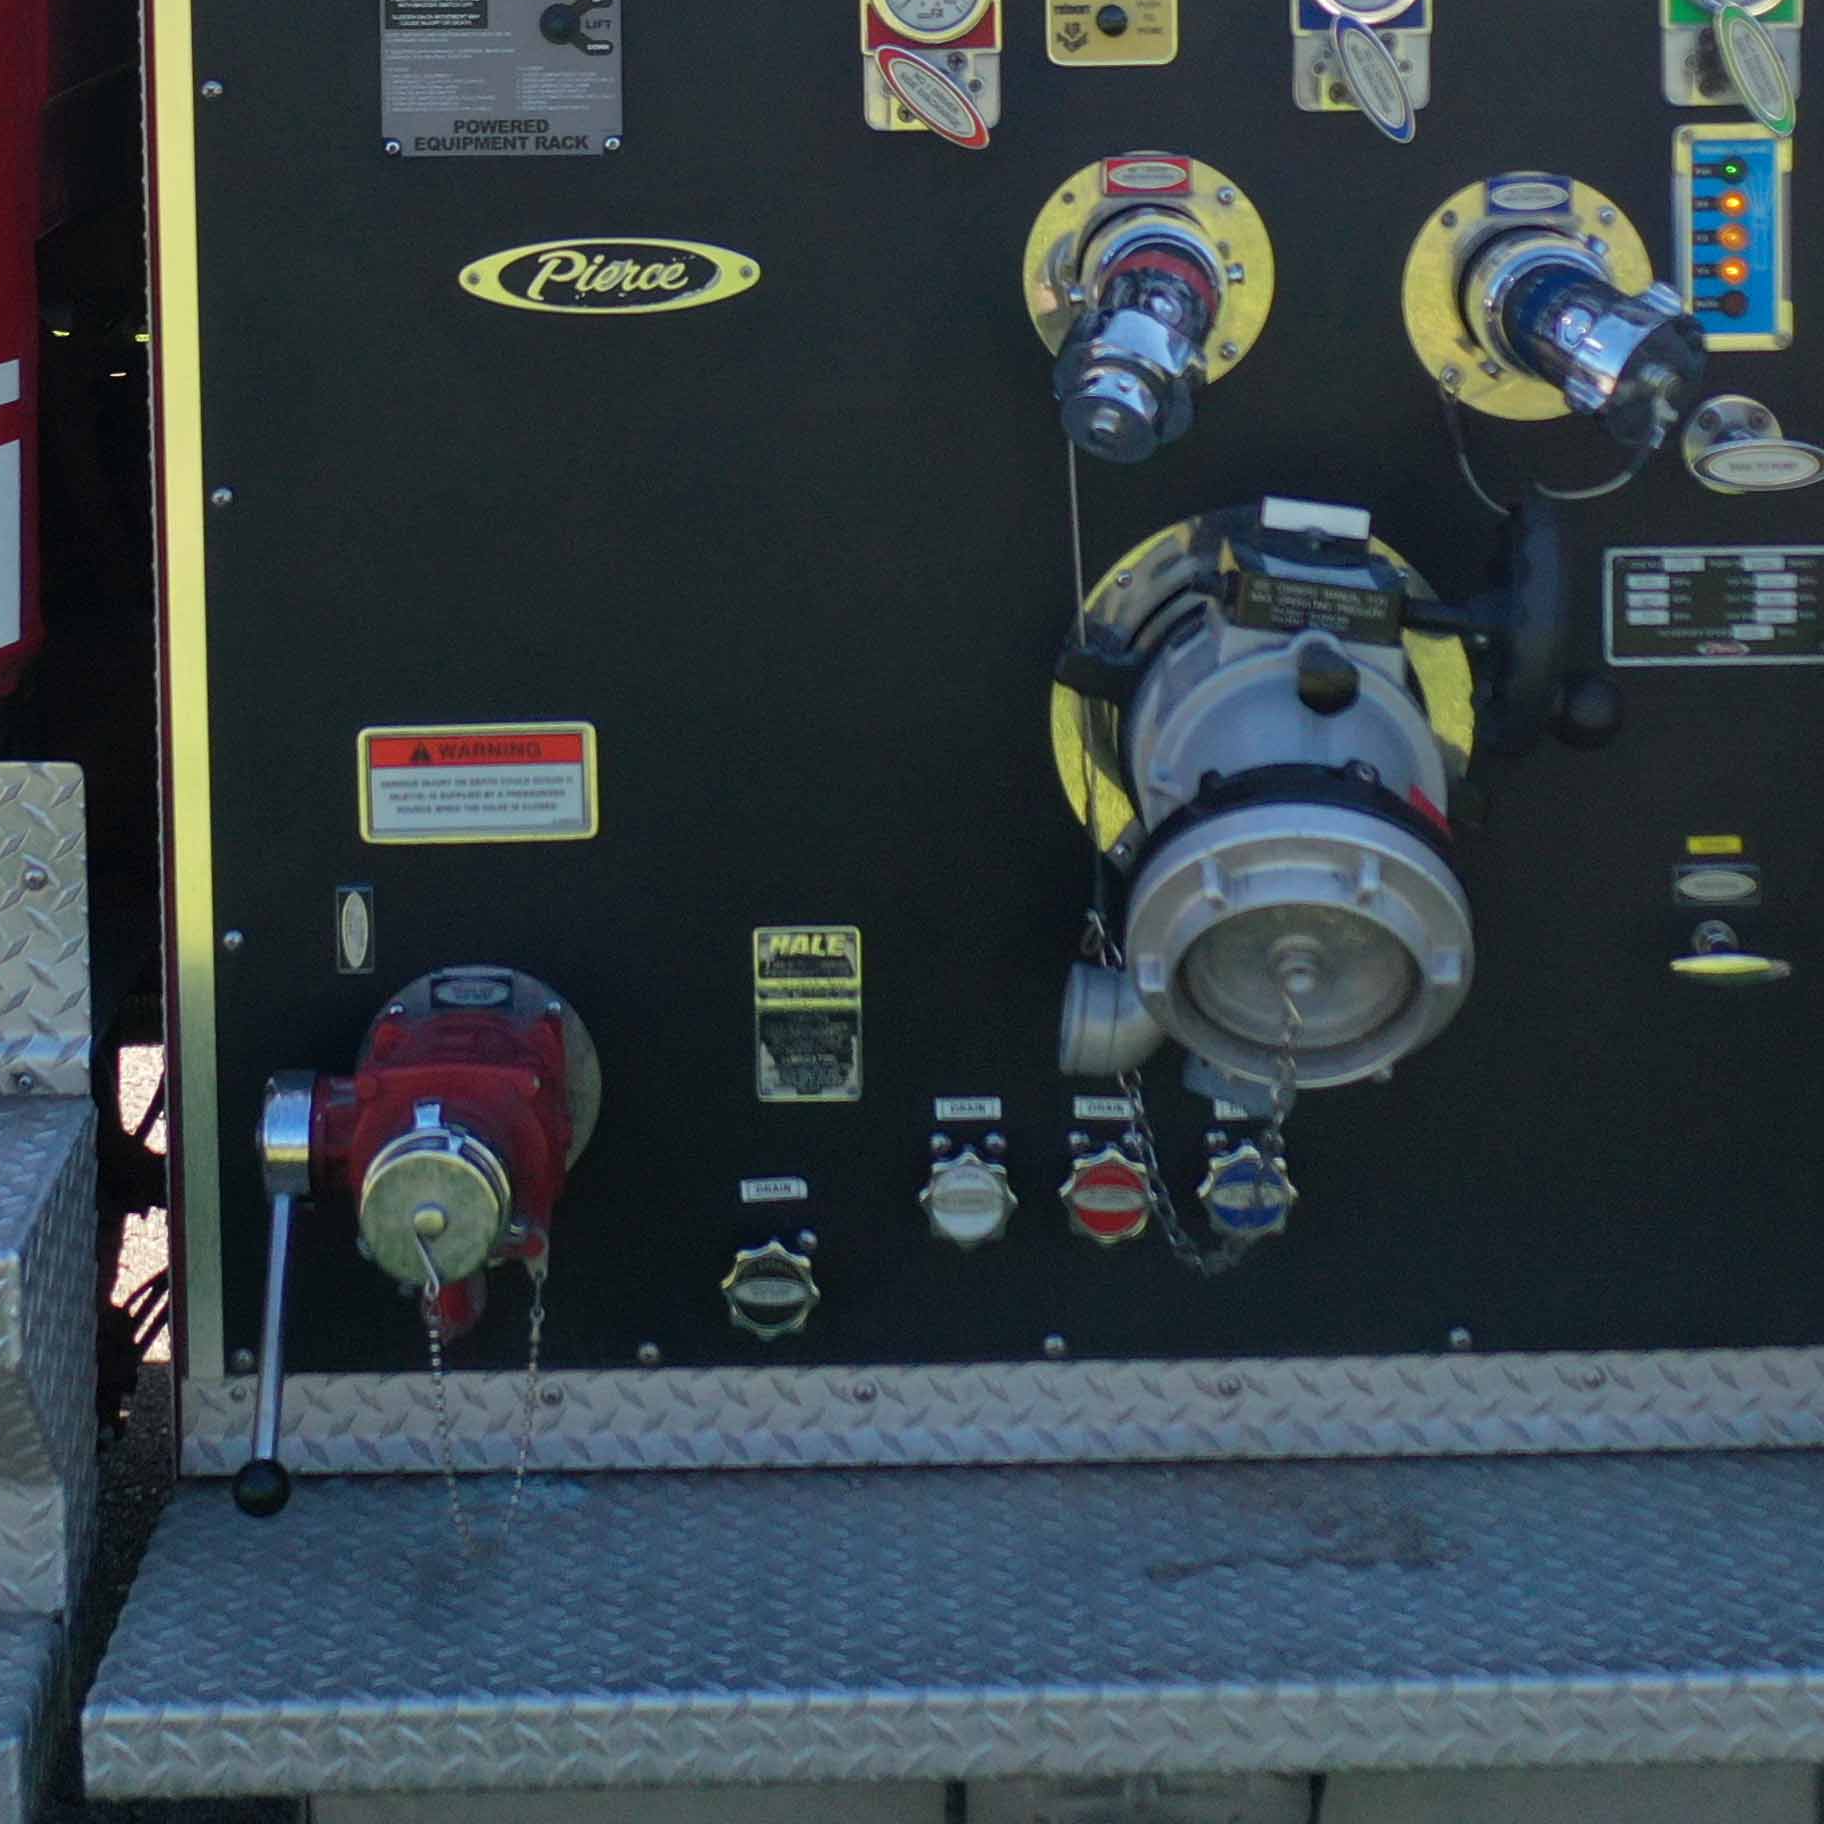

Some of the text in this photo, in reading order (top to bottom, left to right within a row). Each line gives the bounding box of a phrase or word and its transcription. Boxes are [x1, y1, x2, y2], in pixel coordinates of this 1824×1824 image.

[584, 19, 612, 30] LIFT
[453, 119, 550, 134] POWERED
[414, 135, 589, 152] EQUIPMENT RACK
[526, 249, 689, 301] Pierce
[439, 741, 542, 759] WARNING
[950, 1102, 987, 1114] DRAIN
[1087, 1102, 1125, 1114] DRAIN
[756, 1183, 792, 1193] DRAIN
